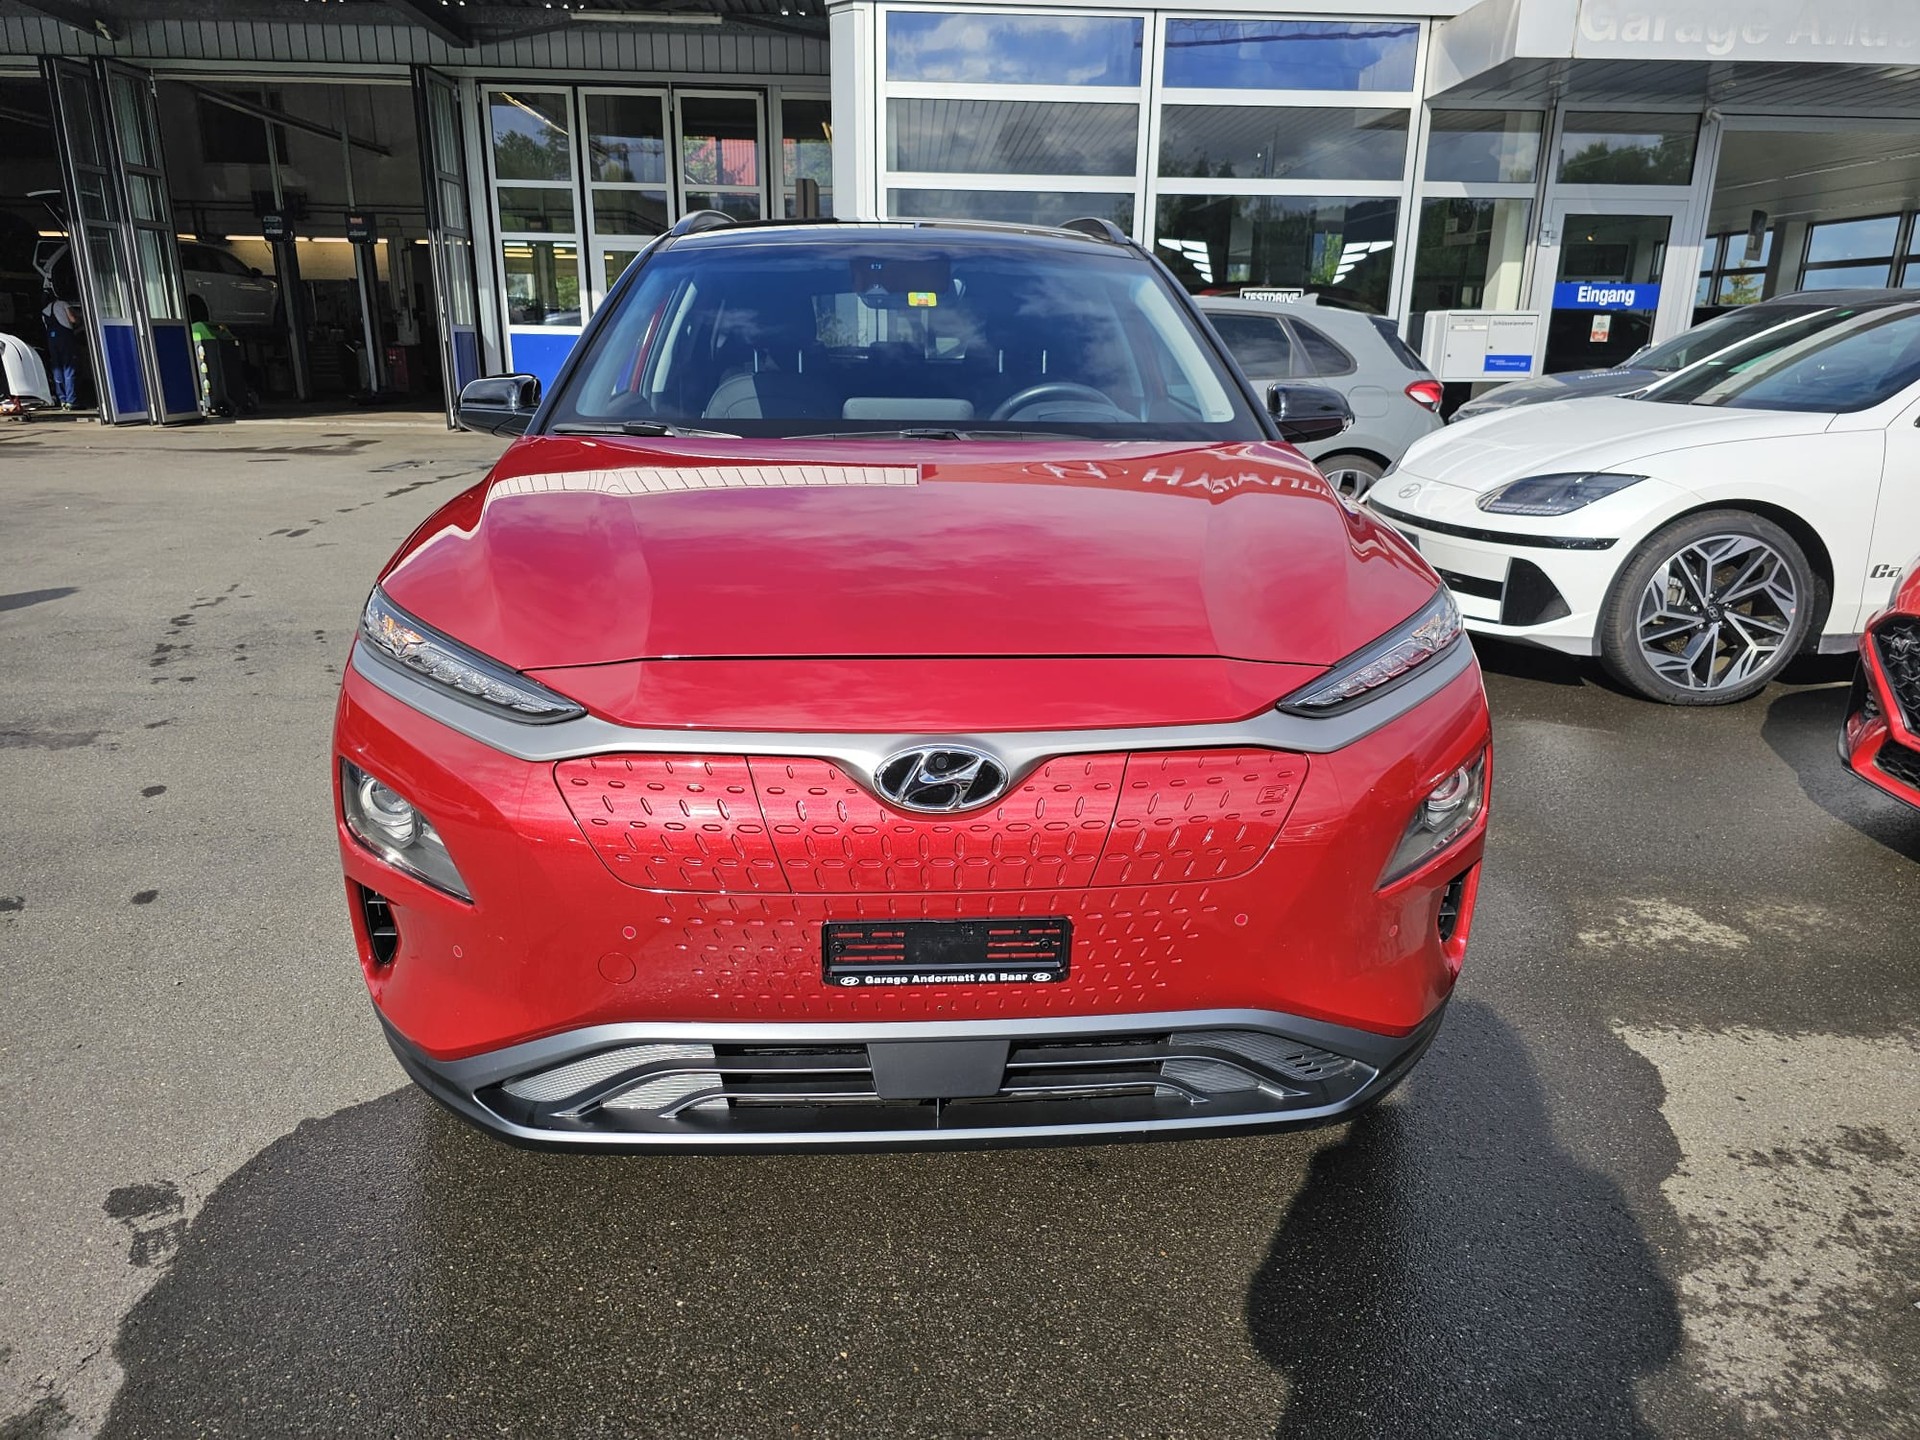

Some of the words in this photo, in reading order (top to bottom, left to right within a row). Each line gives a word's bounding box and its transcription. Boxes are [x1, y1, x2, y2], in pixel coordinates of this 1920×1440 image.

[1579, 3, 1770, 56] Garage
[1577, 285, 1636, 306] Eingang
[864, 975, 908, 985] Garage
[912, 973, 975, 983] Andermatt
[979, 973, 996, 982] AG
[999, 973, 1028, 982] Baar
